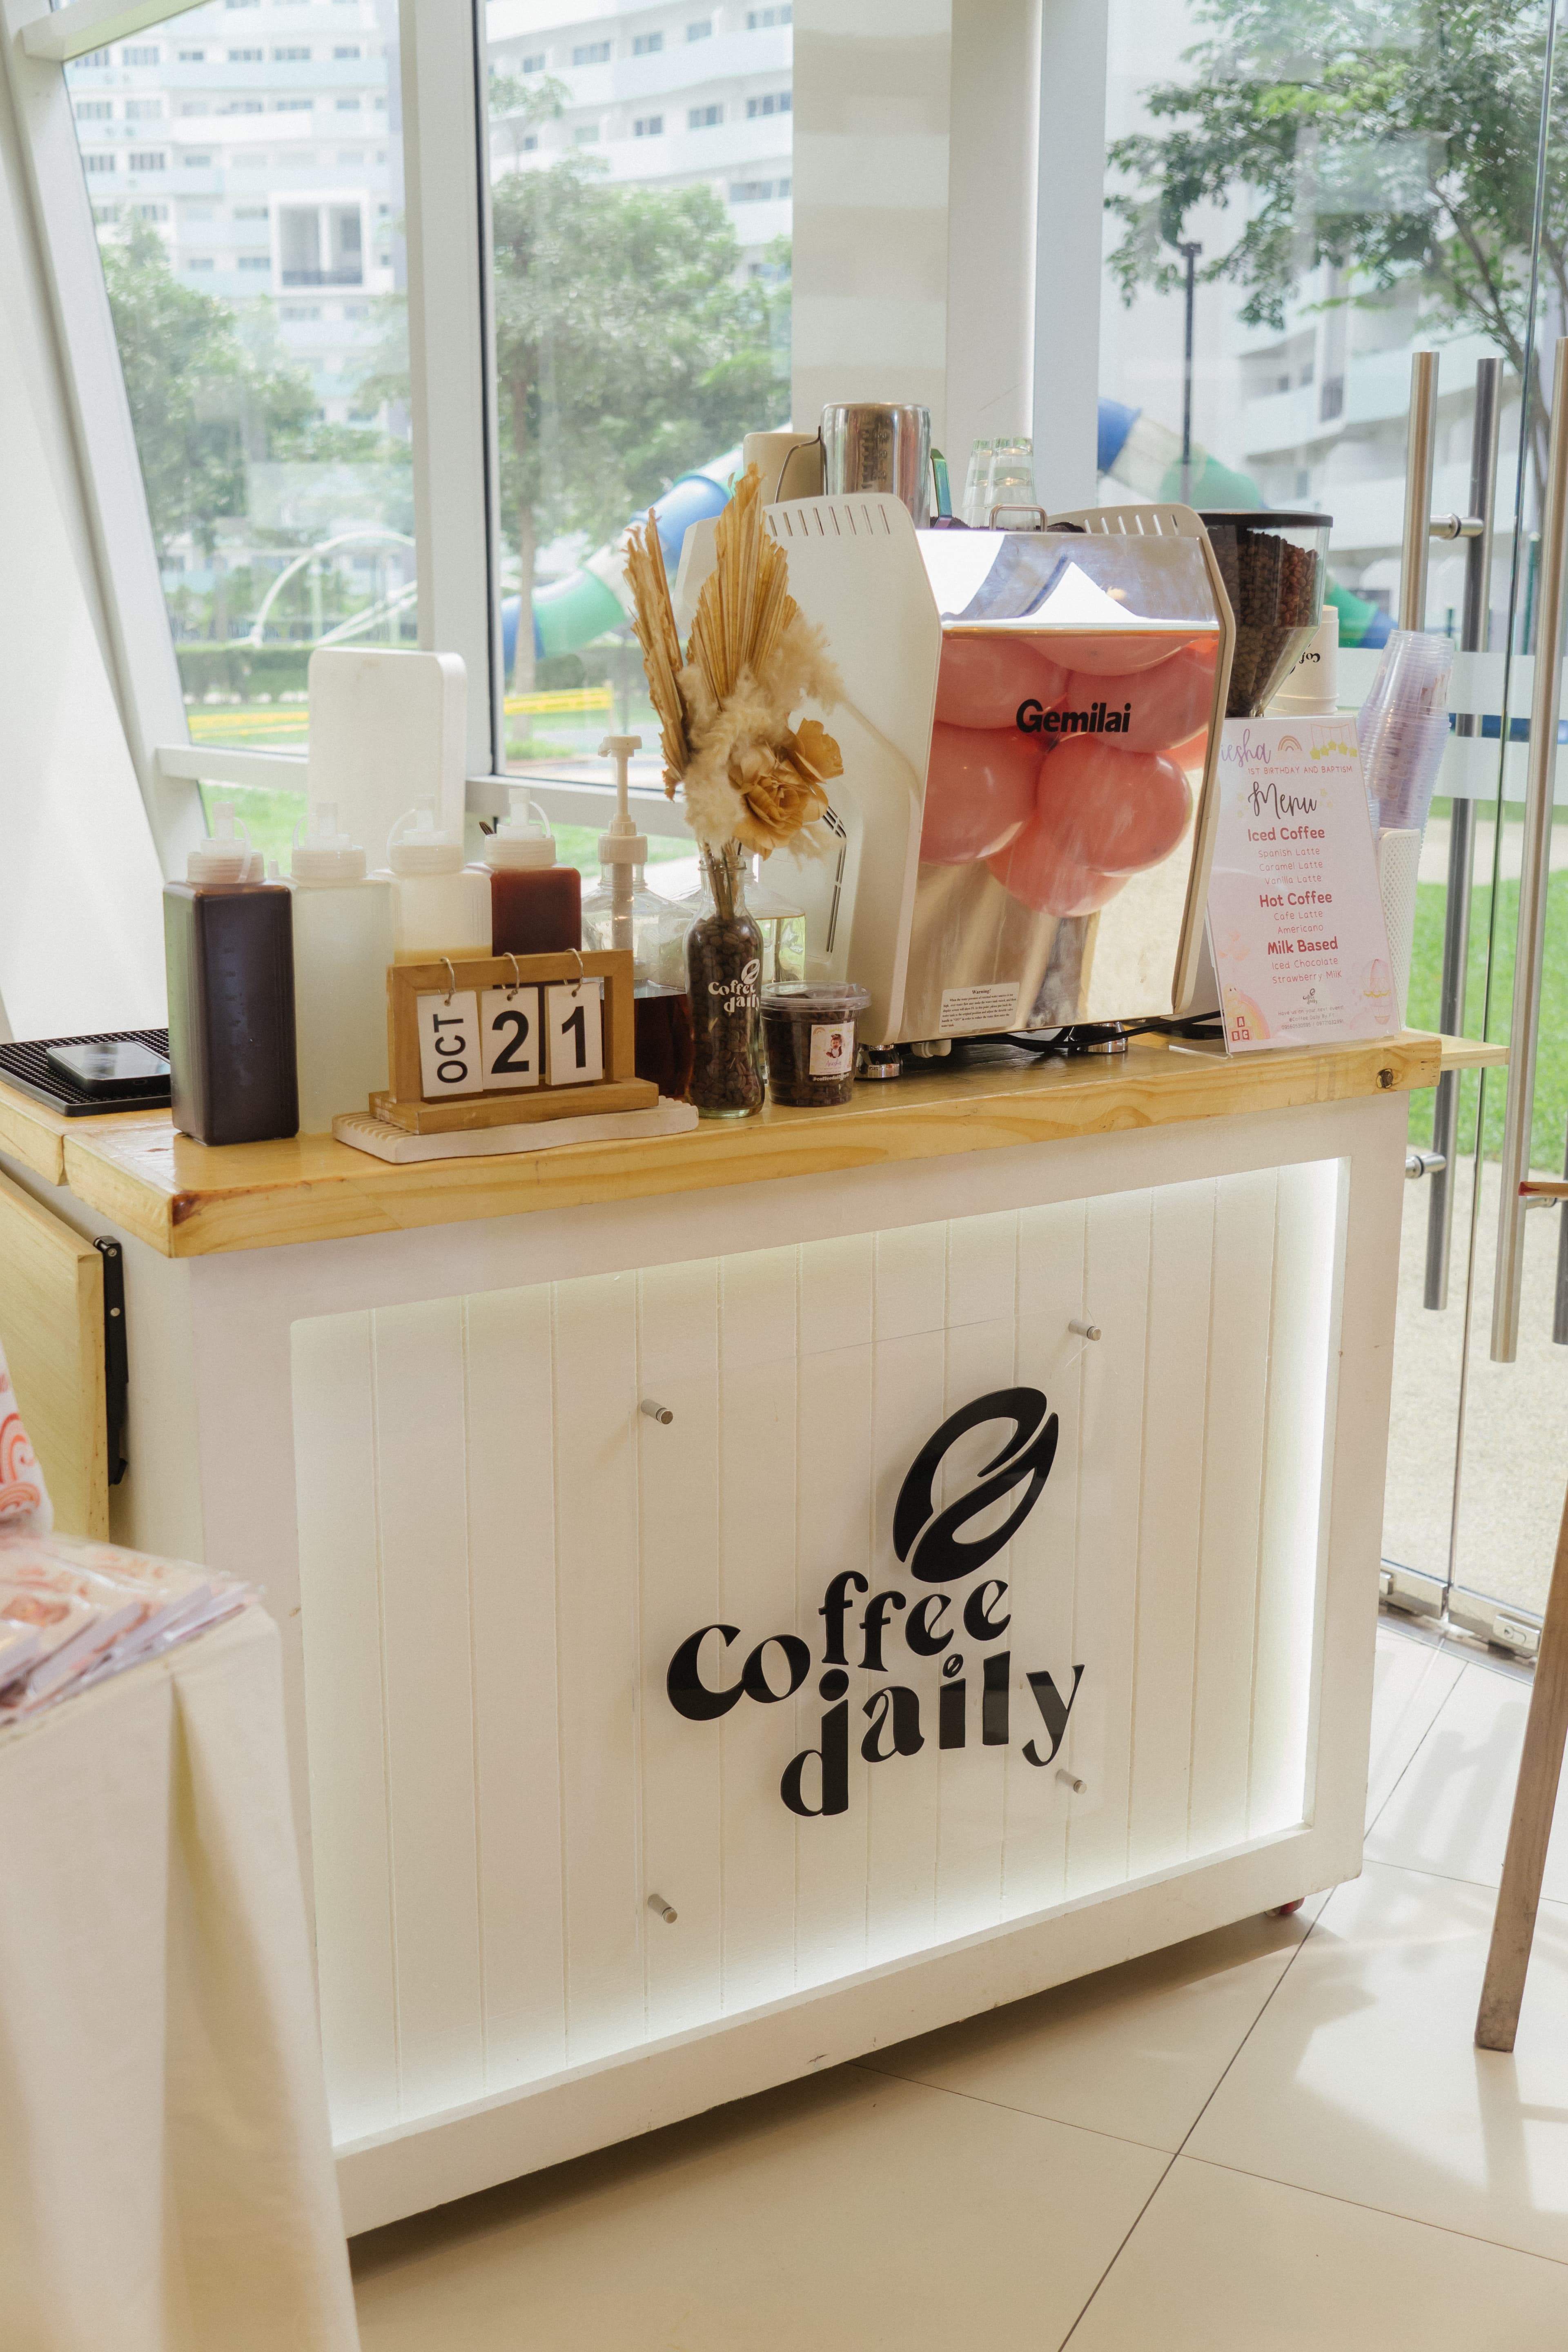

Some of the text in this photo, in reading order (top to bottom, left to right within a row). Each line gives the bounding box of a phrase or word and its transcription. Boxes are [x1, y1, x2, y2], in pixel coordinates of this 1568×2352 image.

[1016, 699, 1131, 733] Gemilai
[1248, 781, 1317, 820] Menu
[1247, 826, 1325, 842] Iced Coffee
[1258, 847, 1320, 859] Spanish Latte
[1259, 861, 1323, 871] Caramel Latte
[1265, 875, 1322, 885] Vanilla Latte
[1259, 891, 1332, 908] Hot Coffee
[1274, 911, 1323, 921] Cafe Latte
[1278, 924, 1323, 934] Americano
[1268, 936, 1338, 955] Milk Based
[1272, 958, 1338, 970] Iced Chocolate
[1272, 973, 1322, 984] Strawberry
[724, 993, 760, 1013] daily
[433, 1013, 468, 1083] OCT
[780, 1650, 1085, 1817] daily
